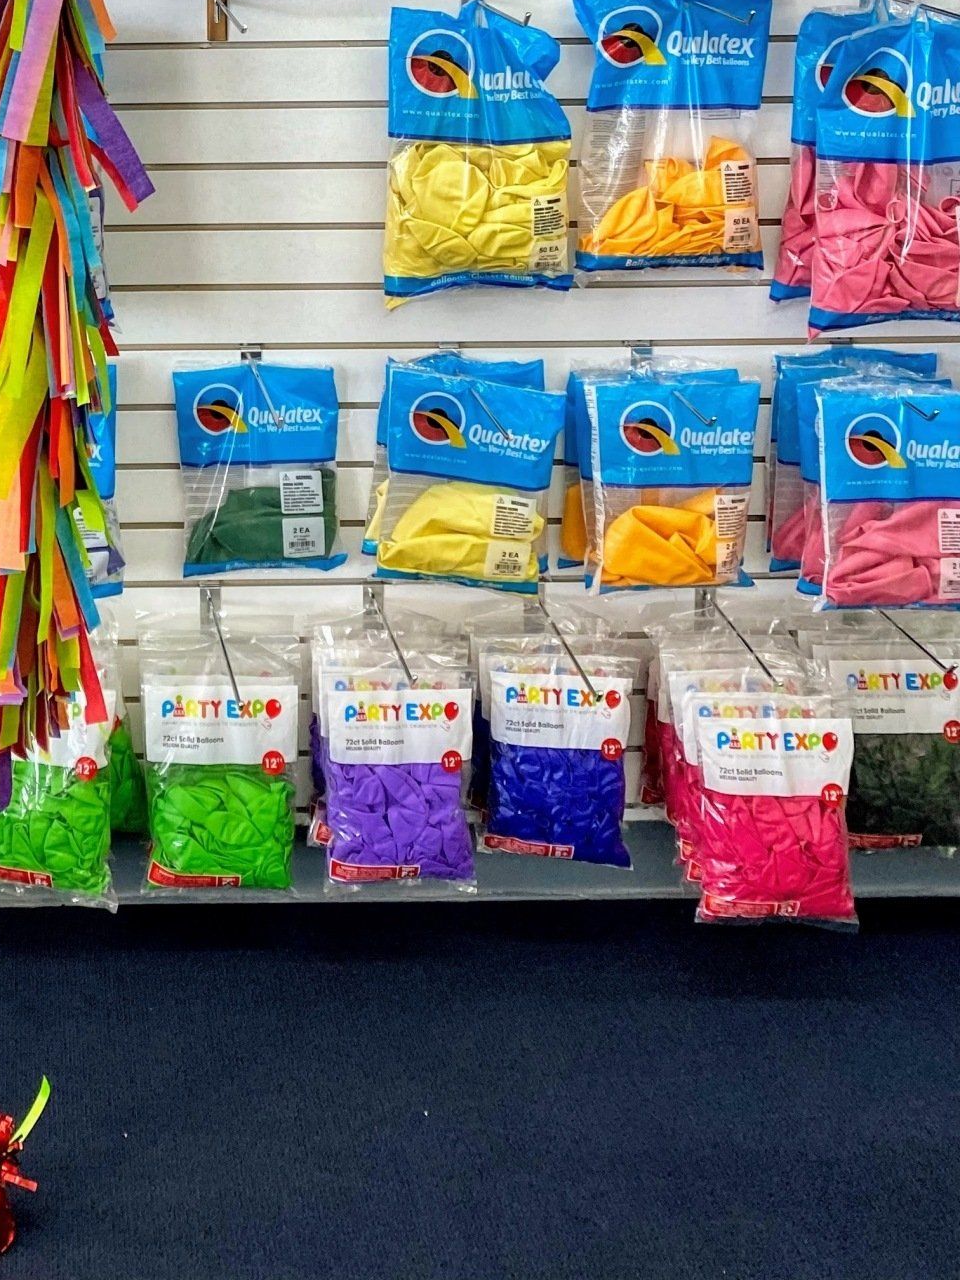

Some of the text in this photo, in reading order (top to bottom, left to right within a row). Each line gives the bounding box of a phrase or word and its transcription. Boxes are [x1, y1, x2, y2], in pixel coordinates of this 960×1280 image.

[666, 30, 756, 57] Qualatex
[293, 526, 311, 534] 2 EA
[501, 551, 520, 559] 2 EA
[603, 743, 622, 756] 12"
[264, 756, 284, 770] 12"
[443, 756, 461, 768] 12"
